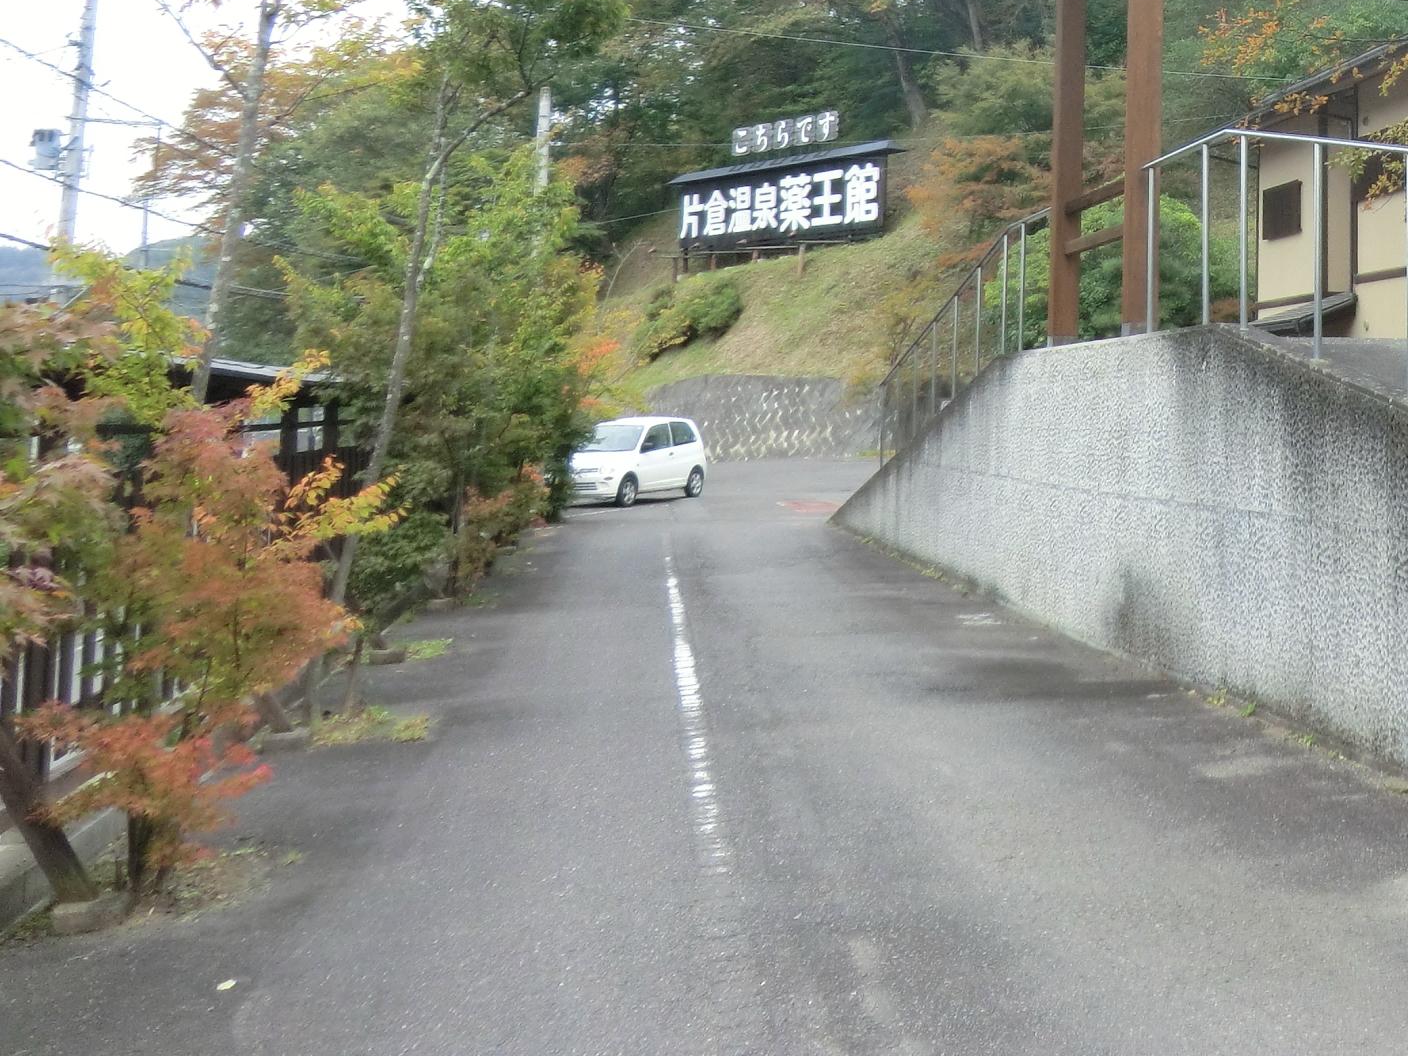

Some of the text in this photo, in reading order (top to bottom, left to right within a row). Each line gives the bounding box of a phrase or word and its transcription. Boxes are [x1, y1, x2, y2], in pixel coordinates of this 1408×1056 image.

[735, 111, 835, 153] こちらです
[680, 163, 880, 239] 片倉温泉薬王館
